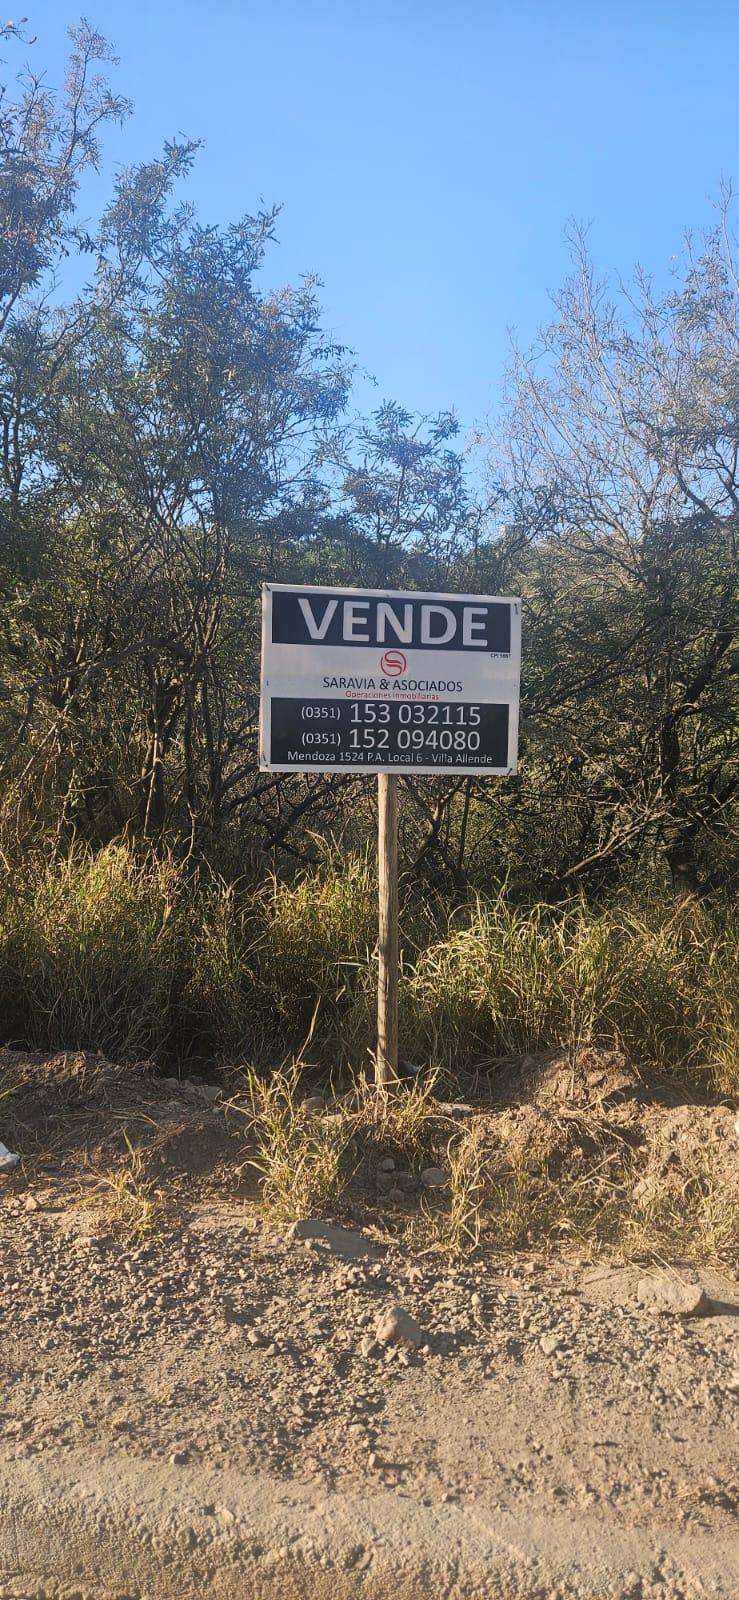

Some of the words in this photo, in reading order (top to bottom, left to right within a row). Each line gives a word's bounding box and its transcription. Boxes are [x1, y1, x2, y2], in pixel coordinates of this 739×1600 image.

[298, 598, 488, 647] VENDE
[323, 676, 375, 690] SARAVIA
[379, 678, 390, 690] &
[392, 679, 463, 692] ASOCIADOS
[345, 690, 391, 699] Operaciones
[392, 692, 439, 700] Inmobiliarias
[301, 705, 341, 720] (0351)
[350, 703, 390, 723] 153
[398, 704, 481, 726] 032115
[301, 732, 341, 747] (0351)
[349, 729, 390, 749] 152
[397, 729, 480, 751] 094080
[287, 751, 336, 761] Mendoza
[339, 751, 364, 762] 1524
[367, 752, 385, 762] P.A.
[388, 752, 414, 763] Local
[416, 753, 423, 763] 6
[432, 753, 453, 763] Villa
[455, 753, 493, 764] Allende
